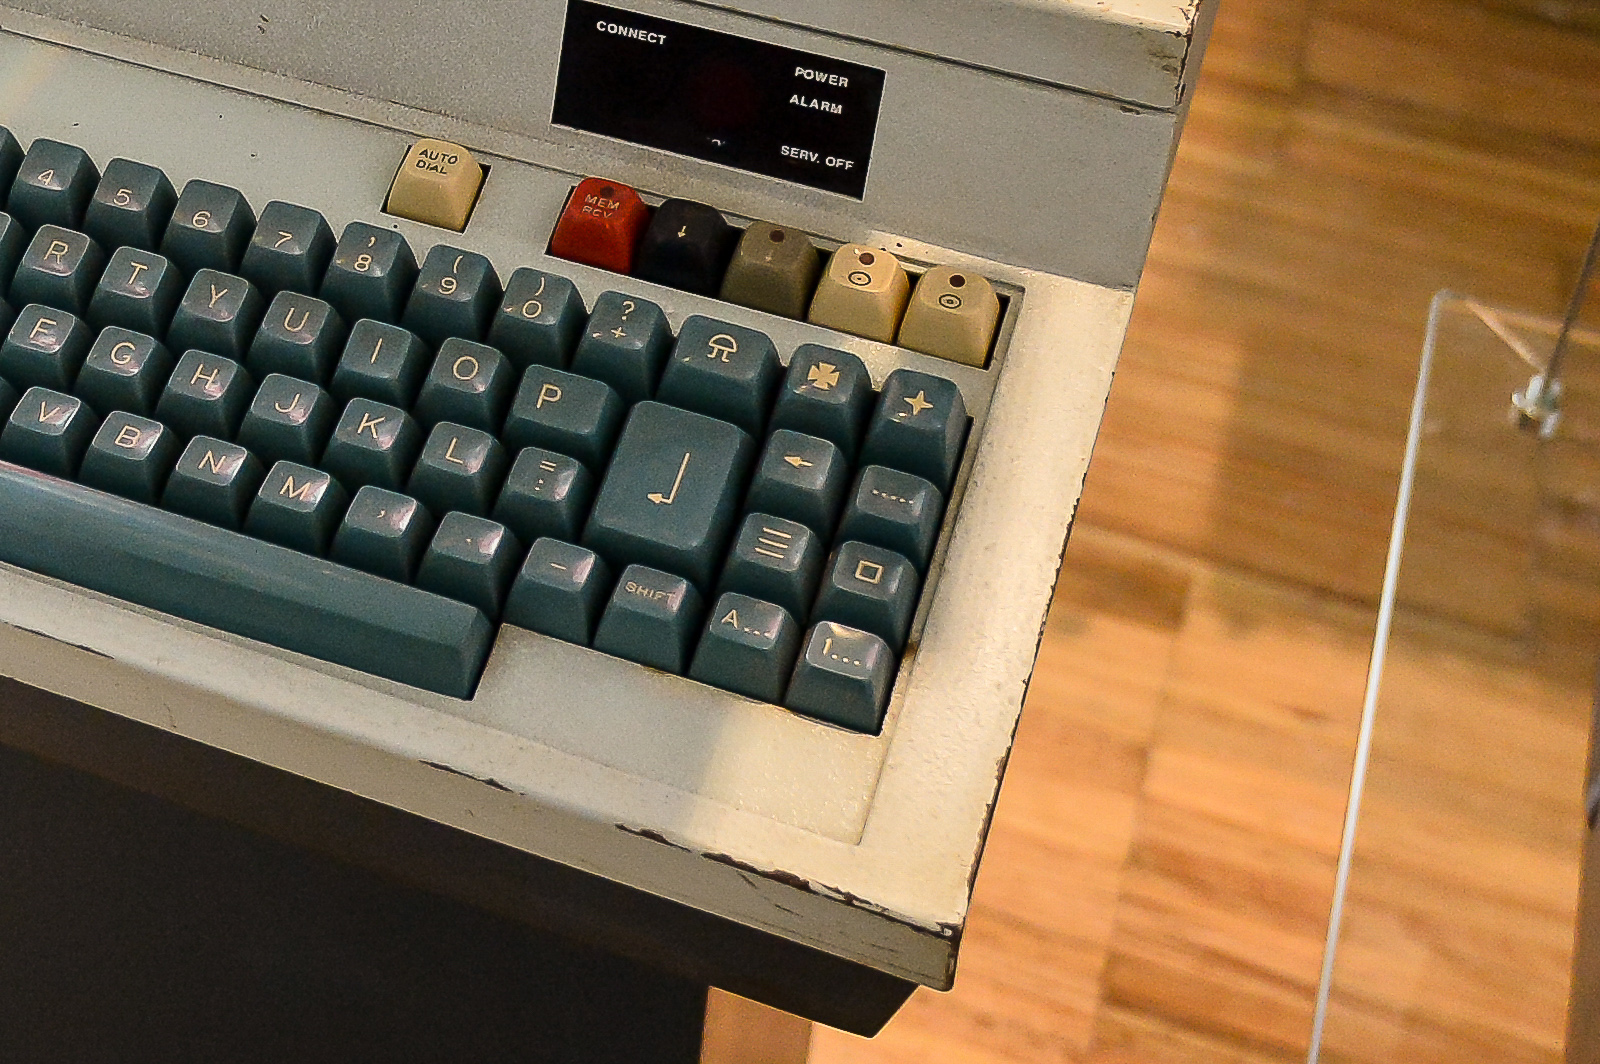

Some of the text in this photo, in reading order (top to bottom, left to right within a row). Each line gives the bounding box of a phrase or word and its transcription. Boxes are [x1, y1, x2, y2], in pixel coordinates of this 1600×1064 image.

[597, 20, 667, 45] CONNECT
[795, 67, 849, 87] POWER
[790, 95, 843, 114] ALARM
[416, 159, 448, 175] DIAL
[418, 147, 458, 165] AUTO
[781, 145, 854, 170] SERV. OFF
[37, 168, 54, 186] 4
[113, 189, 132, 205] 5
[584, 193, 620, 211] MEM
[192, 210, 209, 228] 6
[275, 231, 291, 246] 7
[45, 241, 69, 263] R
[354, 254, 372, 272] 8
[125, 263, 148, 285] T
[205, 284, 228, 308] Y
[439, 277, 456, 295] 9
[30, 318, 57, 339] F
[284, 309, 309, 332] U
[110, 342, 136, 365] G
[189, 364, 218, 386] H
[451, 355, 479, 382] O
[274, 392, 300, 414] J
[536, 384, 562, 409] P
[37, 401, 61, 424] V
[114, 426, 141, 448] B
[357, 415, 386, 438] K
[198, 449, 225, 473] N
[446, 438, 466, 463] L
[278, 476, 310, 500] M
[624, 580, 678, 602] SHIFT
